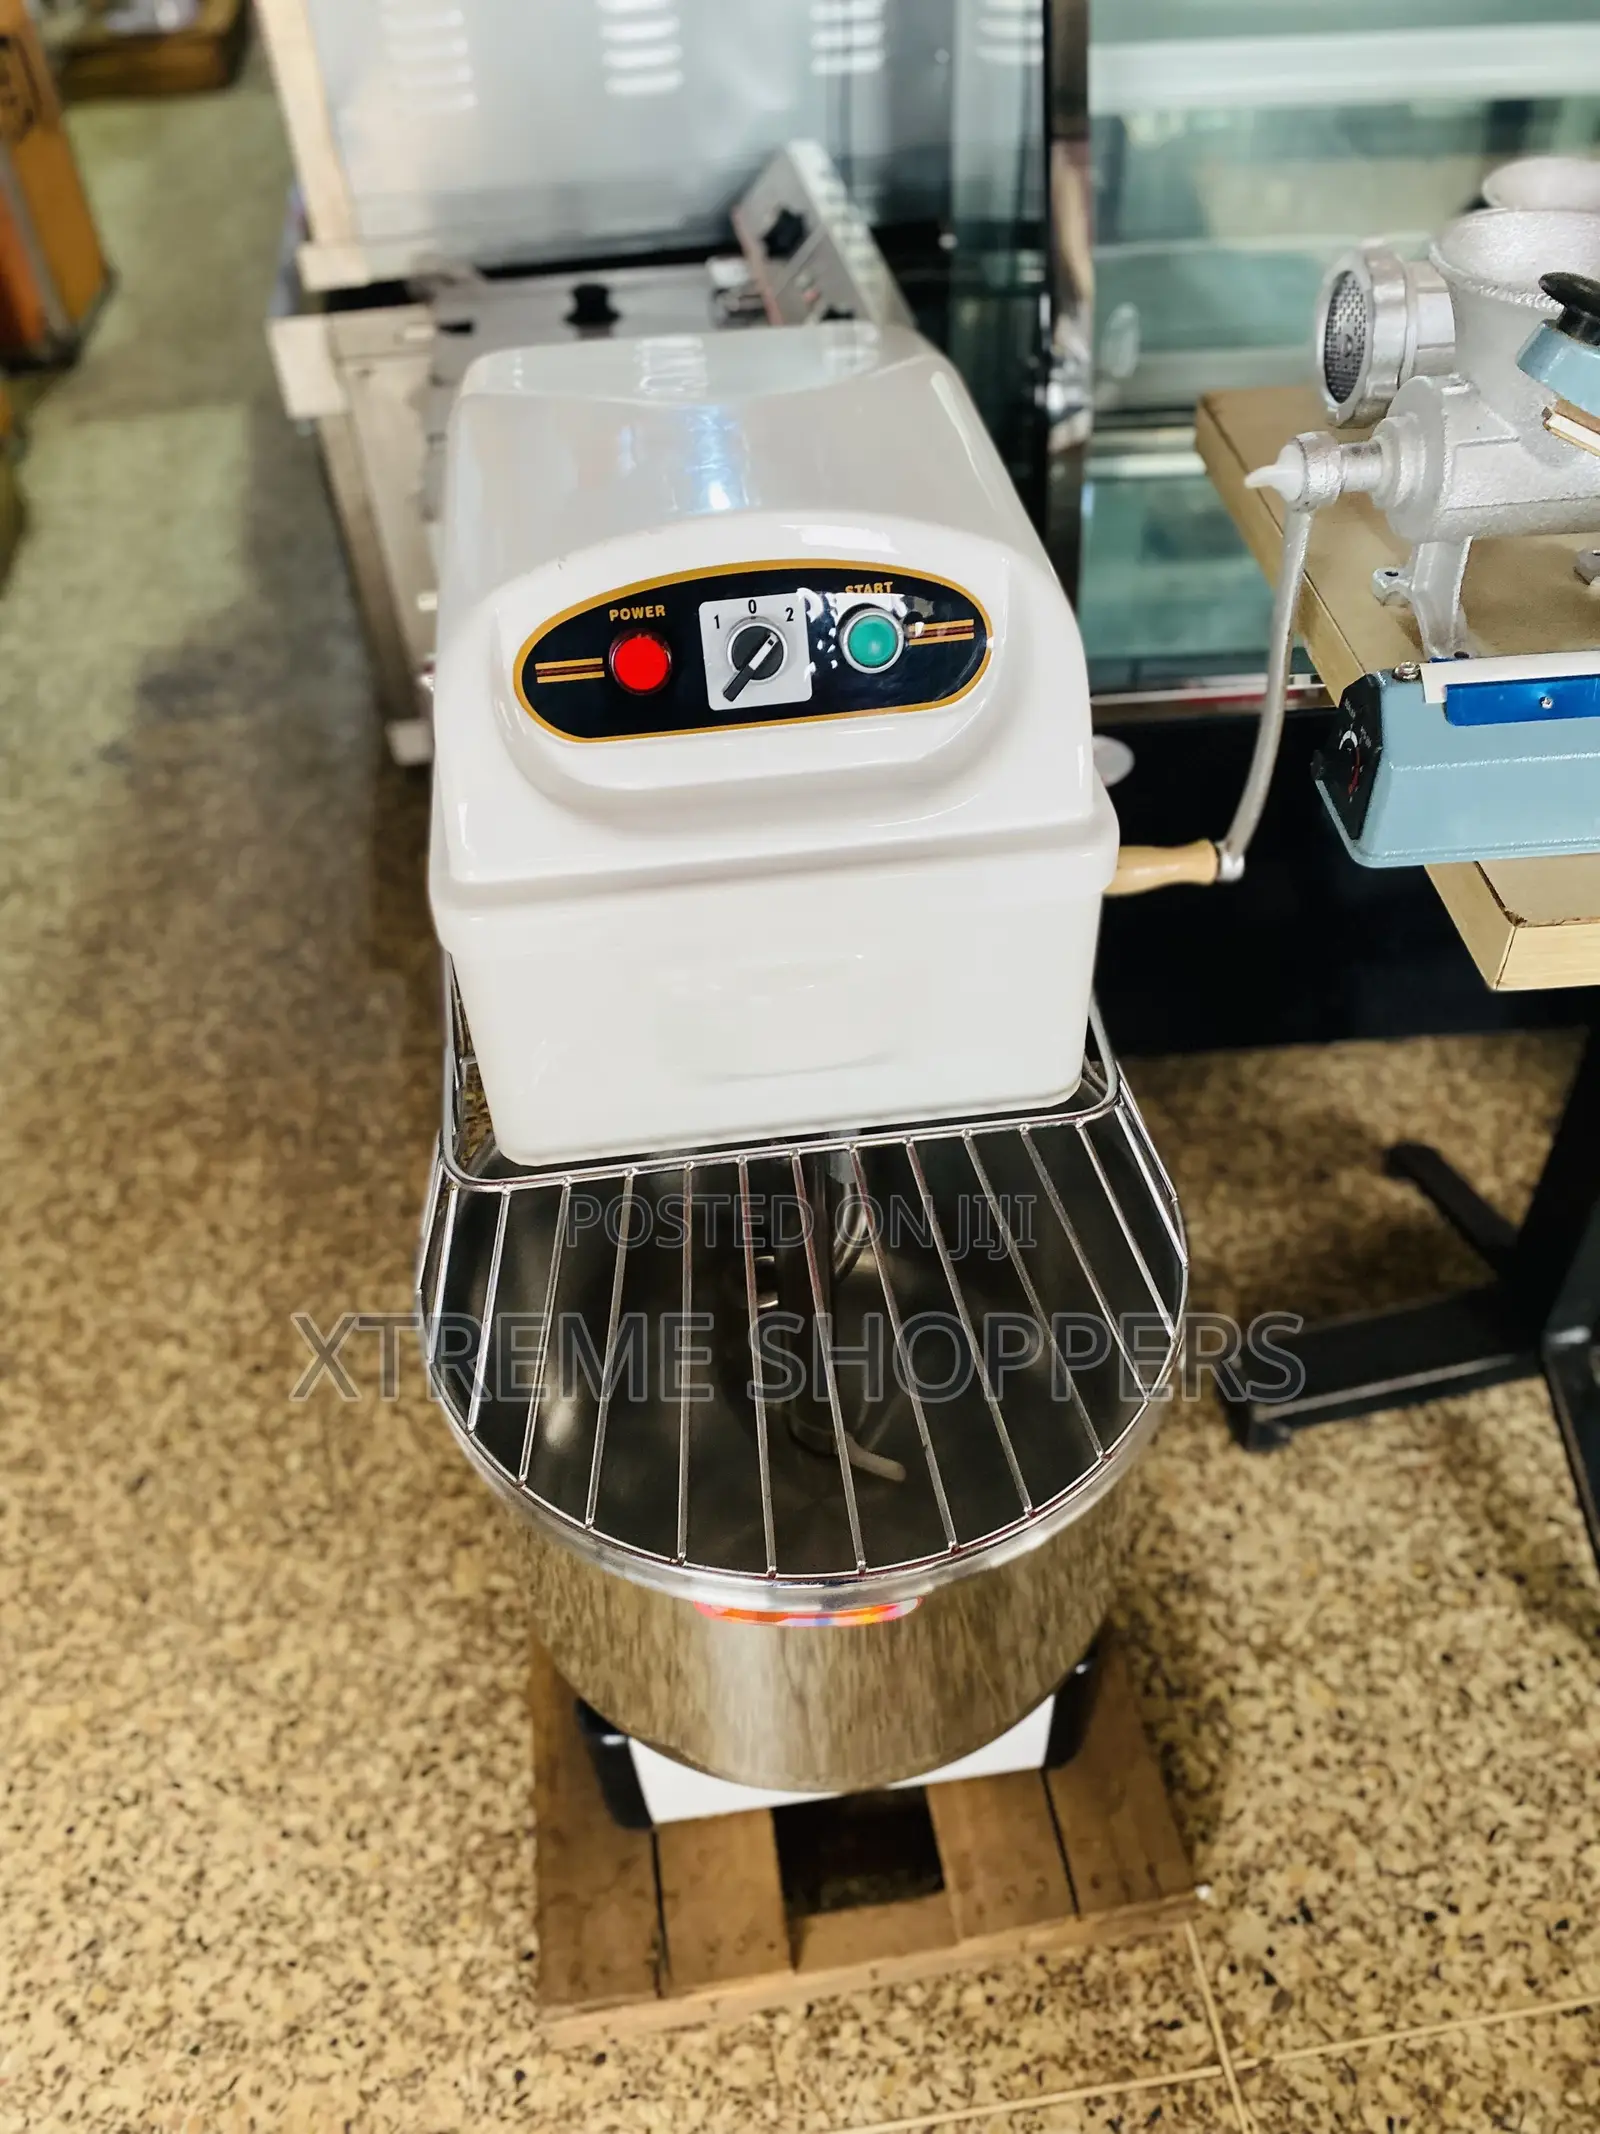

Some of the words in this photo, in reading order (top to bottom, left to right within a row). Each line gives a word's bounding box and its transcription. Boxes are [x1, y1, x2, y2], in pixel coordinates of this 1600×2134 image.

[845, 581, 893, 594] START
[609, 604, 666, 622] POWER
[714, 615, 720, 630] 1
[748, 599, 757, 614] 0
[785, 607, 794, 622] 2
